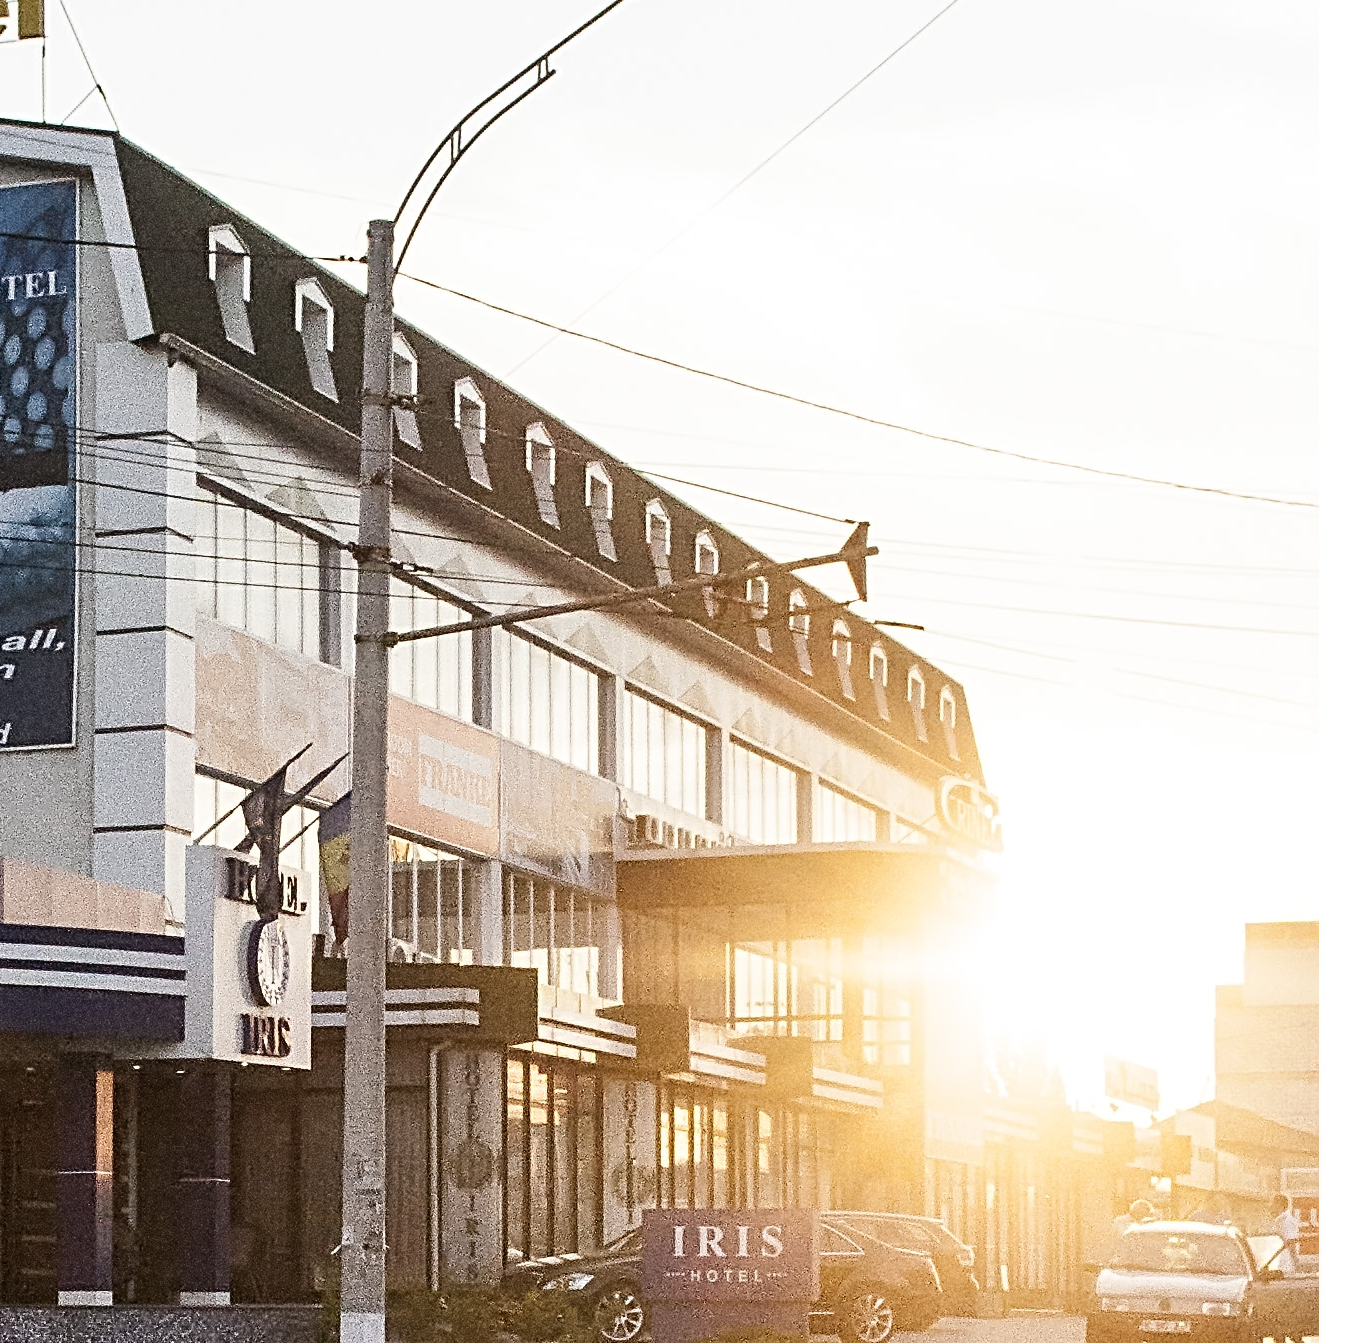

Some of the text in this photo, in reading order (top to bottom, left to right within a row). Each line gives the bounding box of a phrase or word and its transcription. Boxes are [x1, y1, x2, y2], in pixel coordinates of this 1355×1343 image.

[224, 856, 308, 916] HEL
[237, 1012, 293, 1057] IRIS
[672, 1224, 784, 1258] IRIS
[690, 1269, 763, 1283] HOTEL
